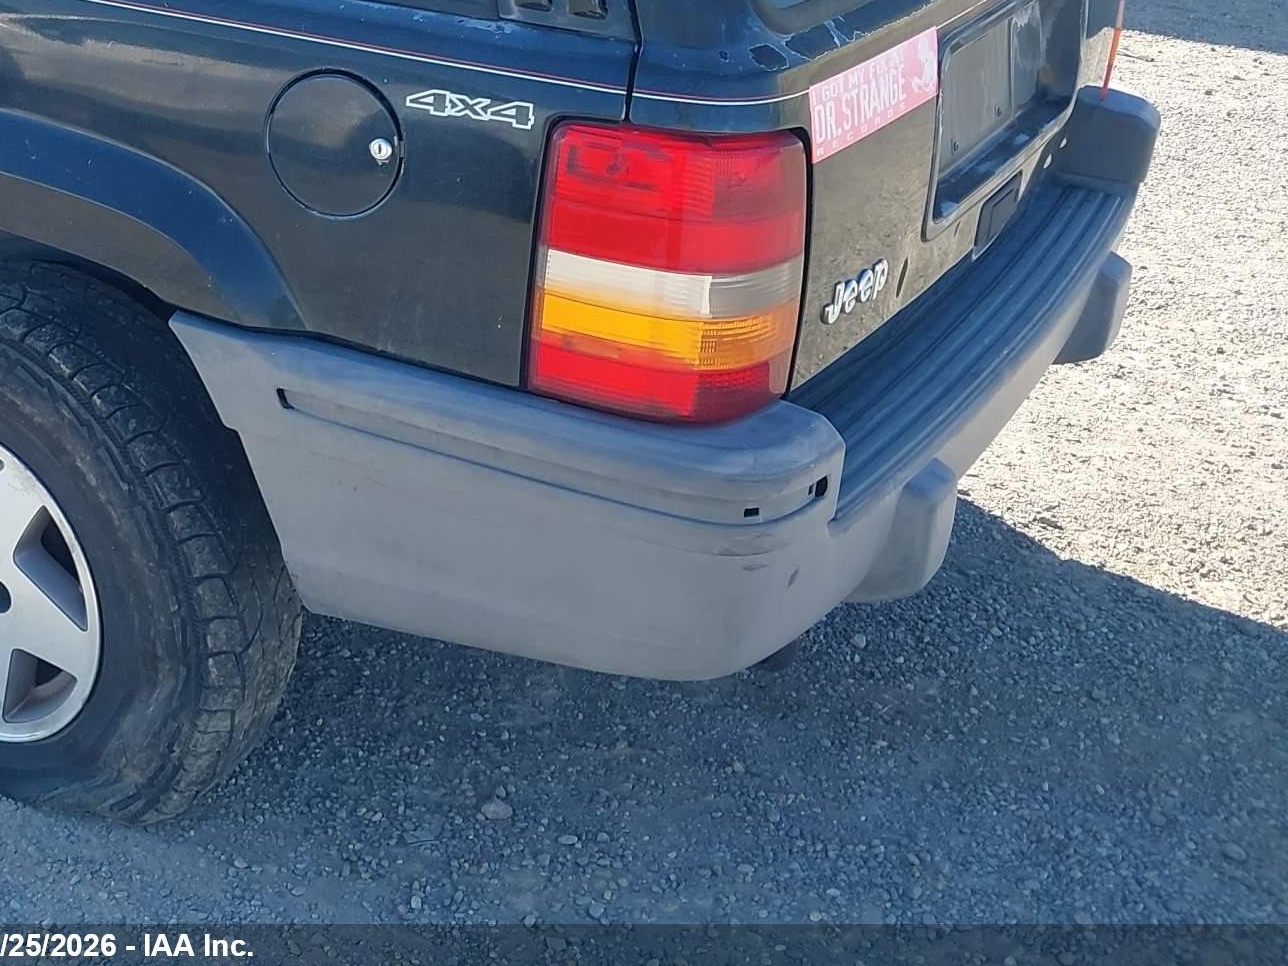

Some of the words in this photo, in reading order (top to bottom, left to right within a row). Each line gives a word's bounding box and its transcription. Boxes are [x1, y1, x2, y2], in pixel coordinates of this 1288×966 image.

[821, 77, 844, 102] GOT
[848, 68, 866, 91] MY
[842, 64, 907, 131] STRANGE
[822, 259, 889, 324] Jeep
